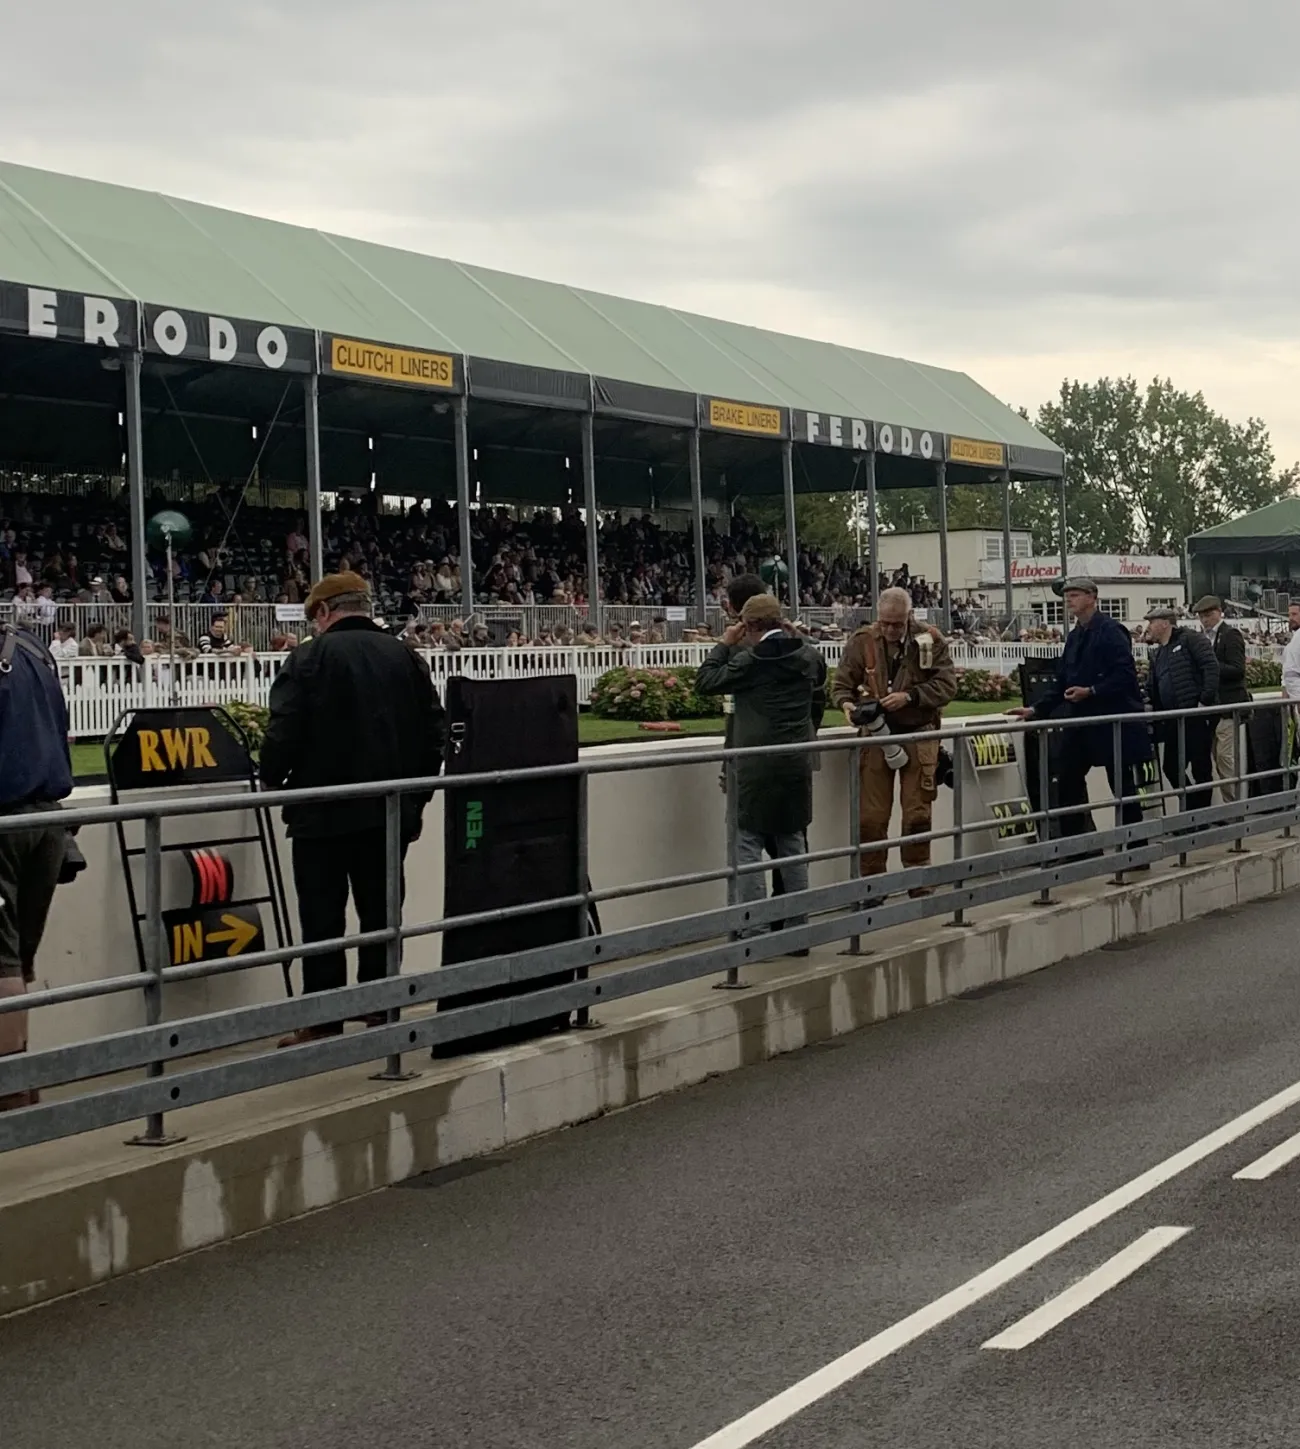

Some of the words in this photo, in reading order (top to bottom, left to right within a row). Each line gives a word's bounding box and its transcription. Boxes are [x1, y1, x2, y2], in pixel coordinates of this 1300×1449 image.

[28, 287, 288, 369] ERODO
[337, 345, 394, 374] CLUTCH
[401, 356, 450, 381] LINERS
[713, 406, 743, 425] BRAKE
[747, 412, 777, 429] LINERS
[807, 413, 934, 459] FERODO
[1009, 559, 1061, 578] Autocar
[1119, 558, 1151, 575] Autocar
[137, 727, 218, 773] RWR
[173, 920, 203, 964] IN
